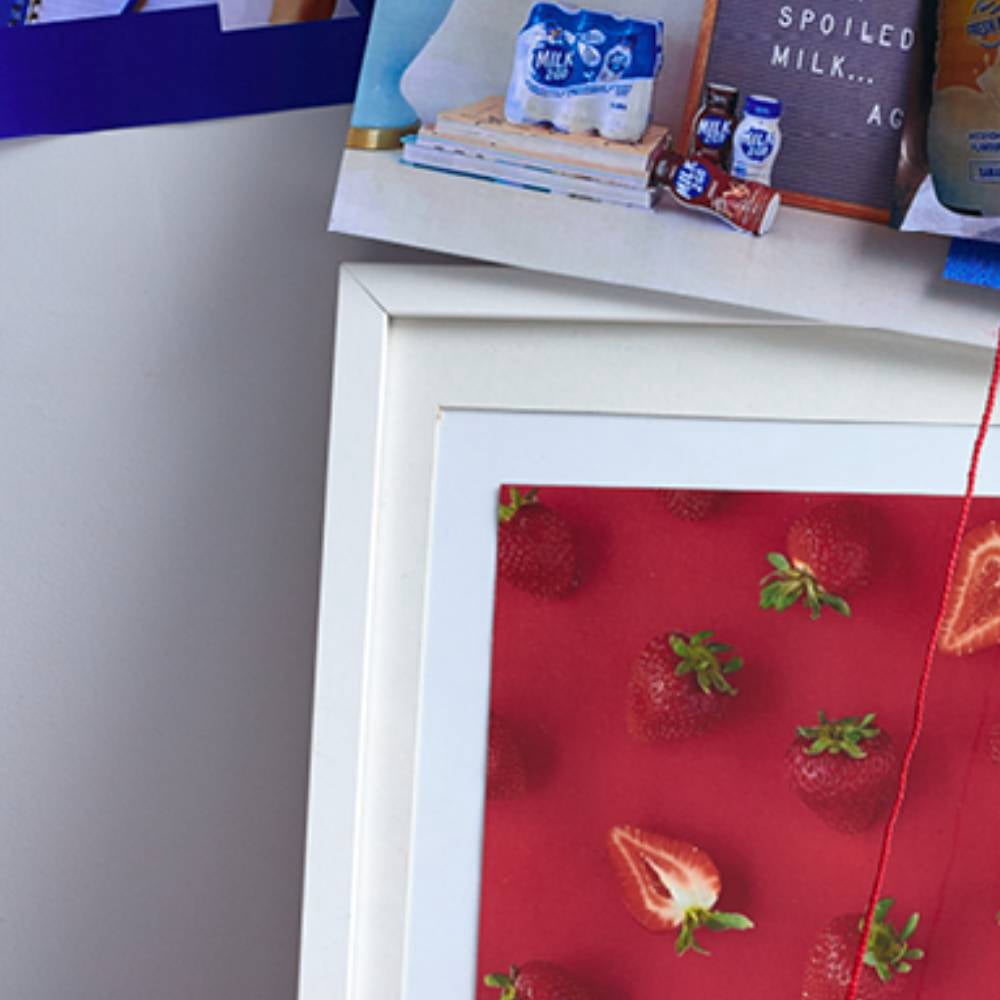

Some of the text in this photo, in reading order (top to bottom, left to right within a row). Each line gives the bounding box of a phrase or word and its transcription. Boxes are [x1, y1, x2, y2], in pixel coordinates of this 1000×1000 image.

[778, 6, 914, 50] SPOILED
[535, 47, 574, 67] MILK
[771, 45, 873, 84] MILK...
[697, 117, 733, 136] MILK
